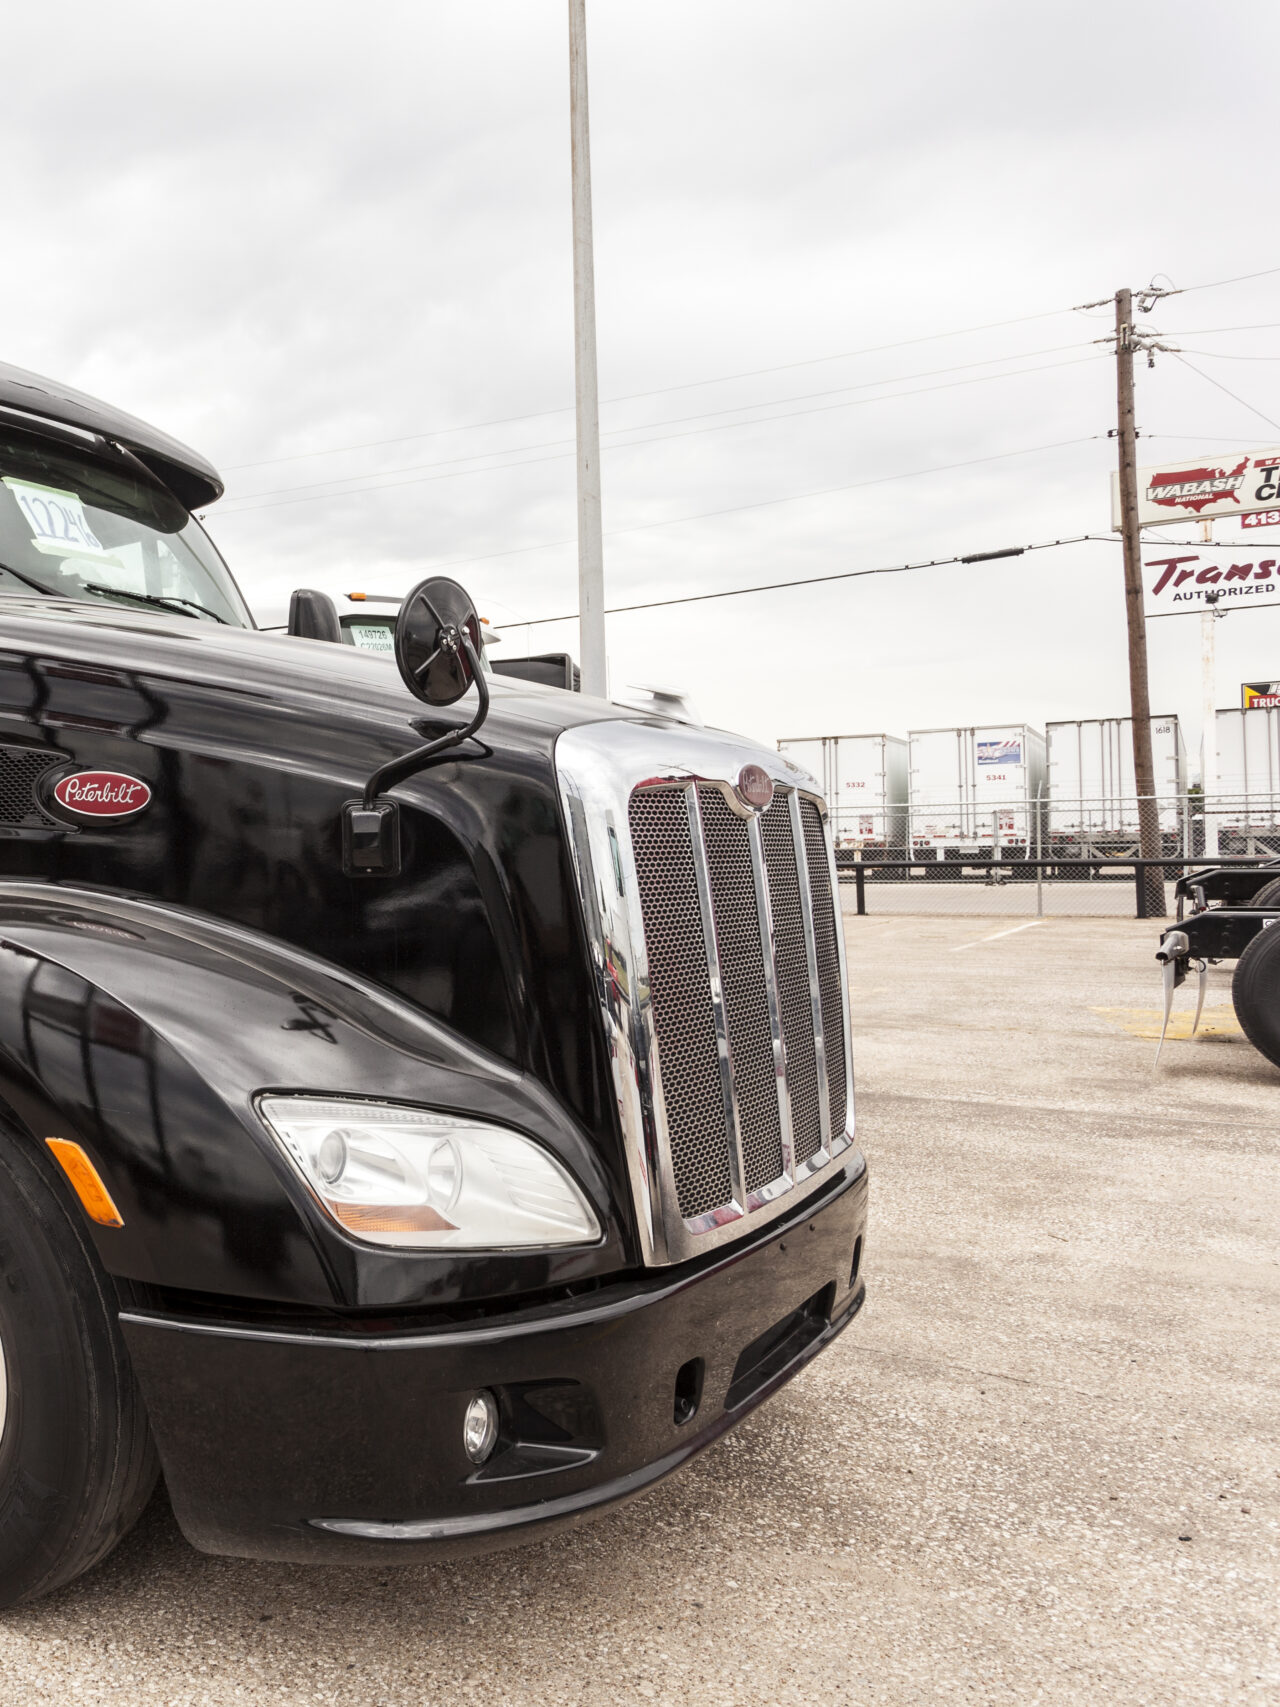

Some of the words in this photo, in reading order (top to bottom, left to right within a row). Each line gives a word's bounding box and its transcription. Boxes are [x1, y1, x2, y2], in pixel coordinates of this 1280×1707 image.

[1147, 476, 1242, 499] WABASH
[1174, 493, 1214, 504] NATIONAL
[1144, 555, 1280, 597] Trans
[358, 630, 388, 640] 149726
[65, 778, 142, 804] Peterbilt
[846, 781, 866, 789] 5332
